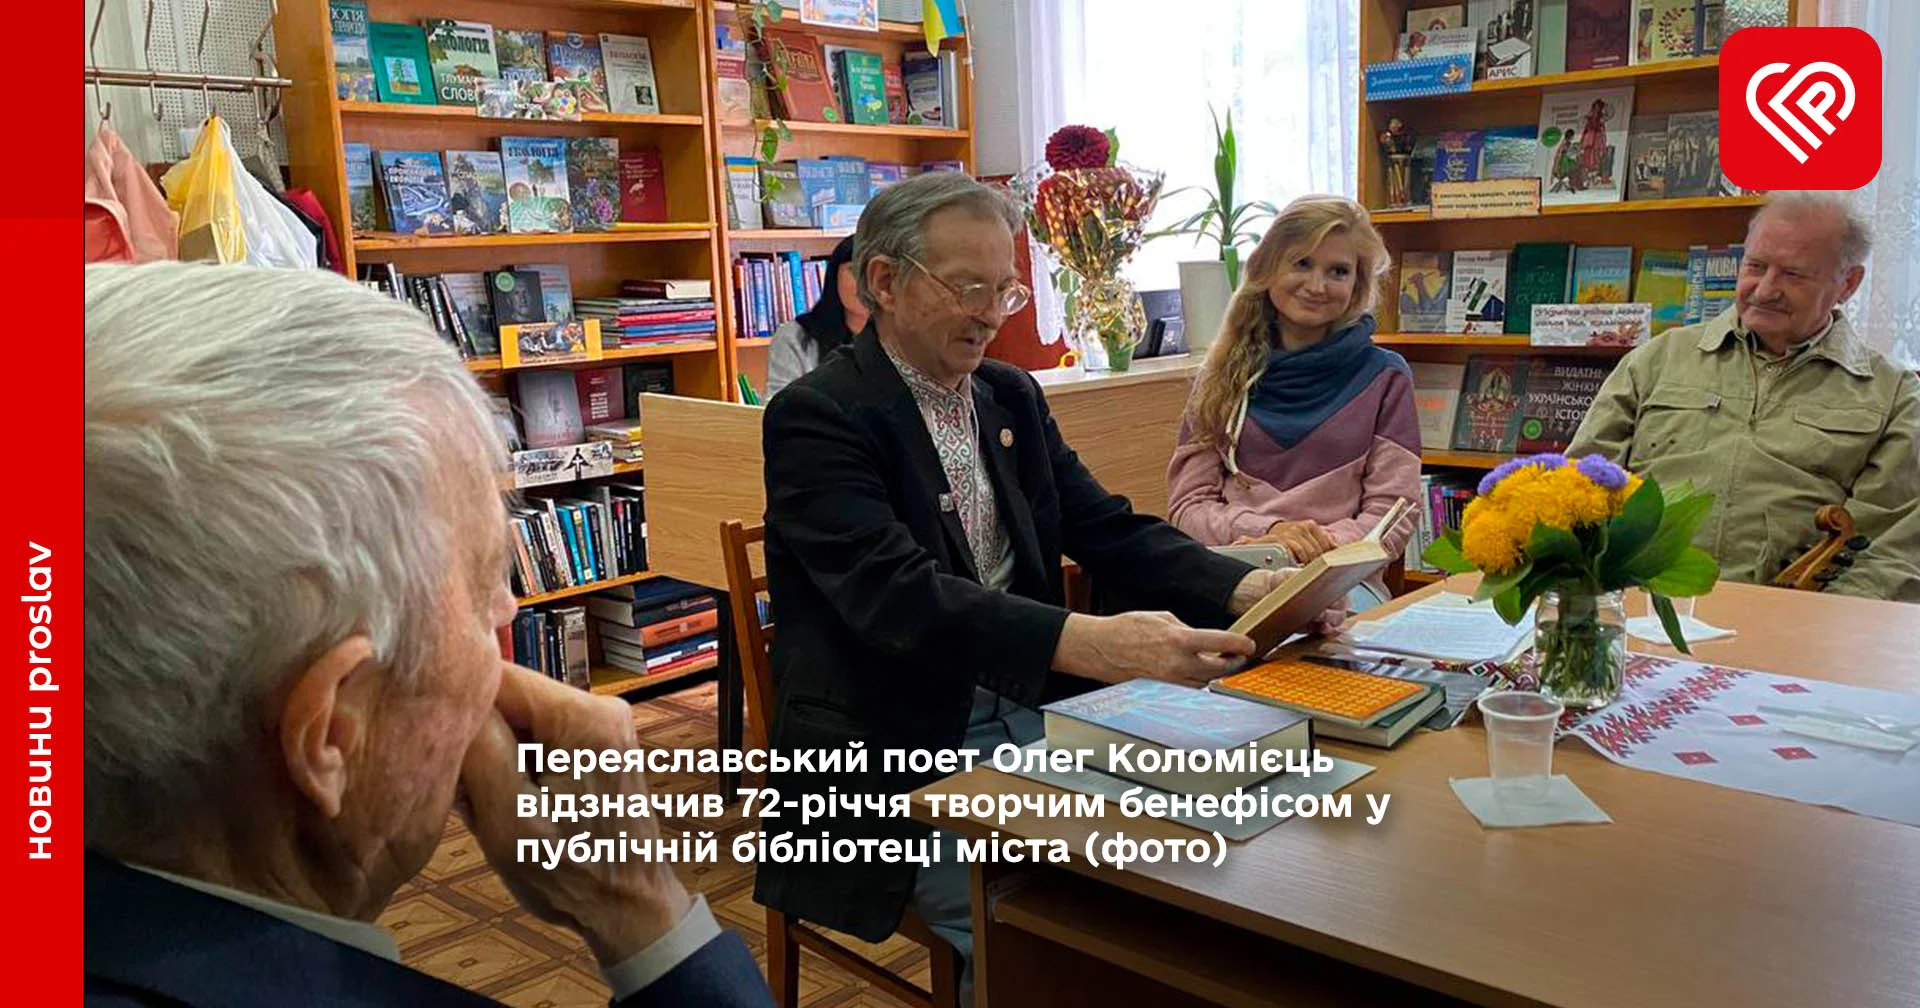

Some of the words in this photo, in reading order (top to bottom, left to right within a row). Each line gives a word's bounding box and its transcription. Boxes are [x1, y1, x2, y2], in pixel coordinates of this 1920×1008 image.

[440, 72, 477, 85] ТЛУМА
[1488, 66, 1518, 78] АРИС
[441, 86, 475, 101] СЛОВ
[1528, 393, 1593, 407] УКРАЇНСЬКО
